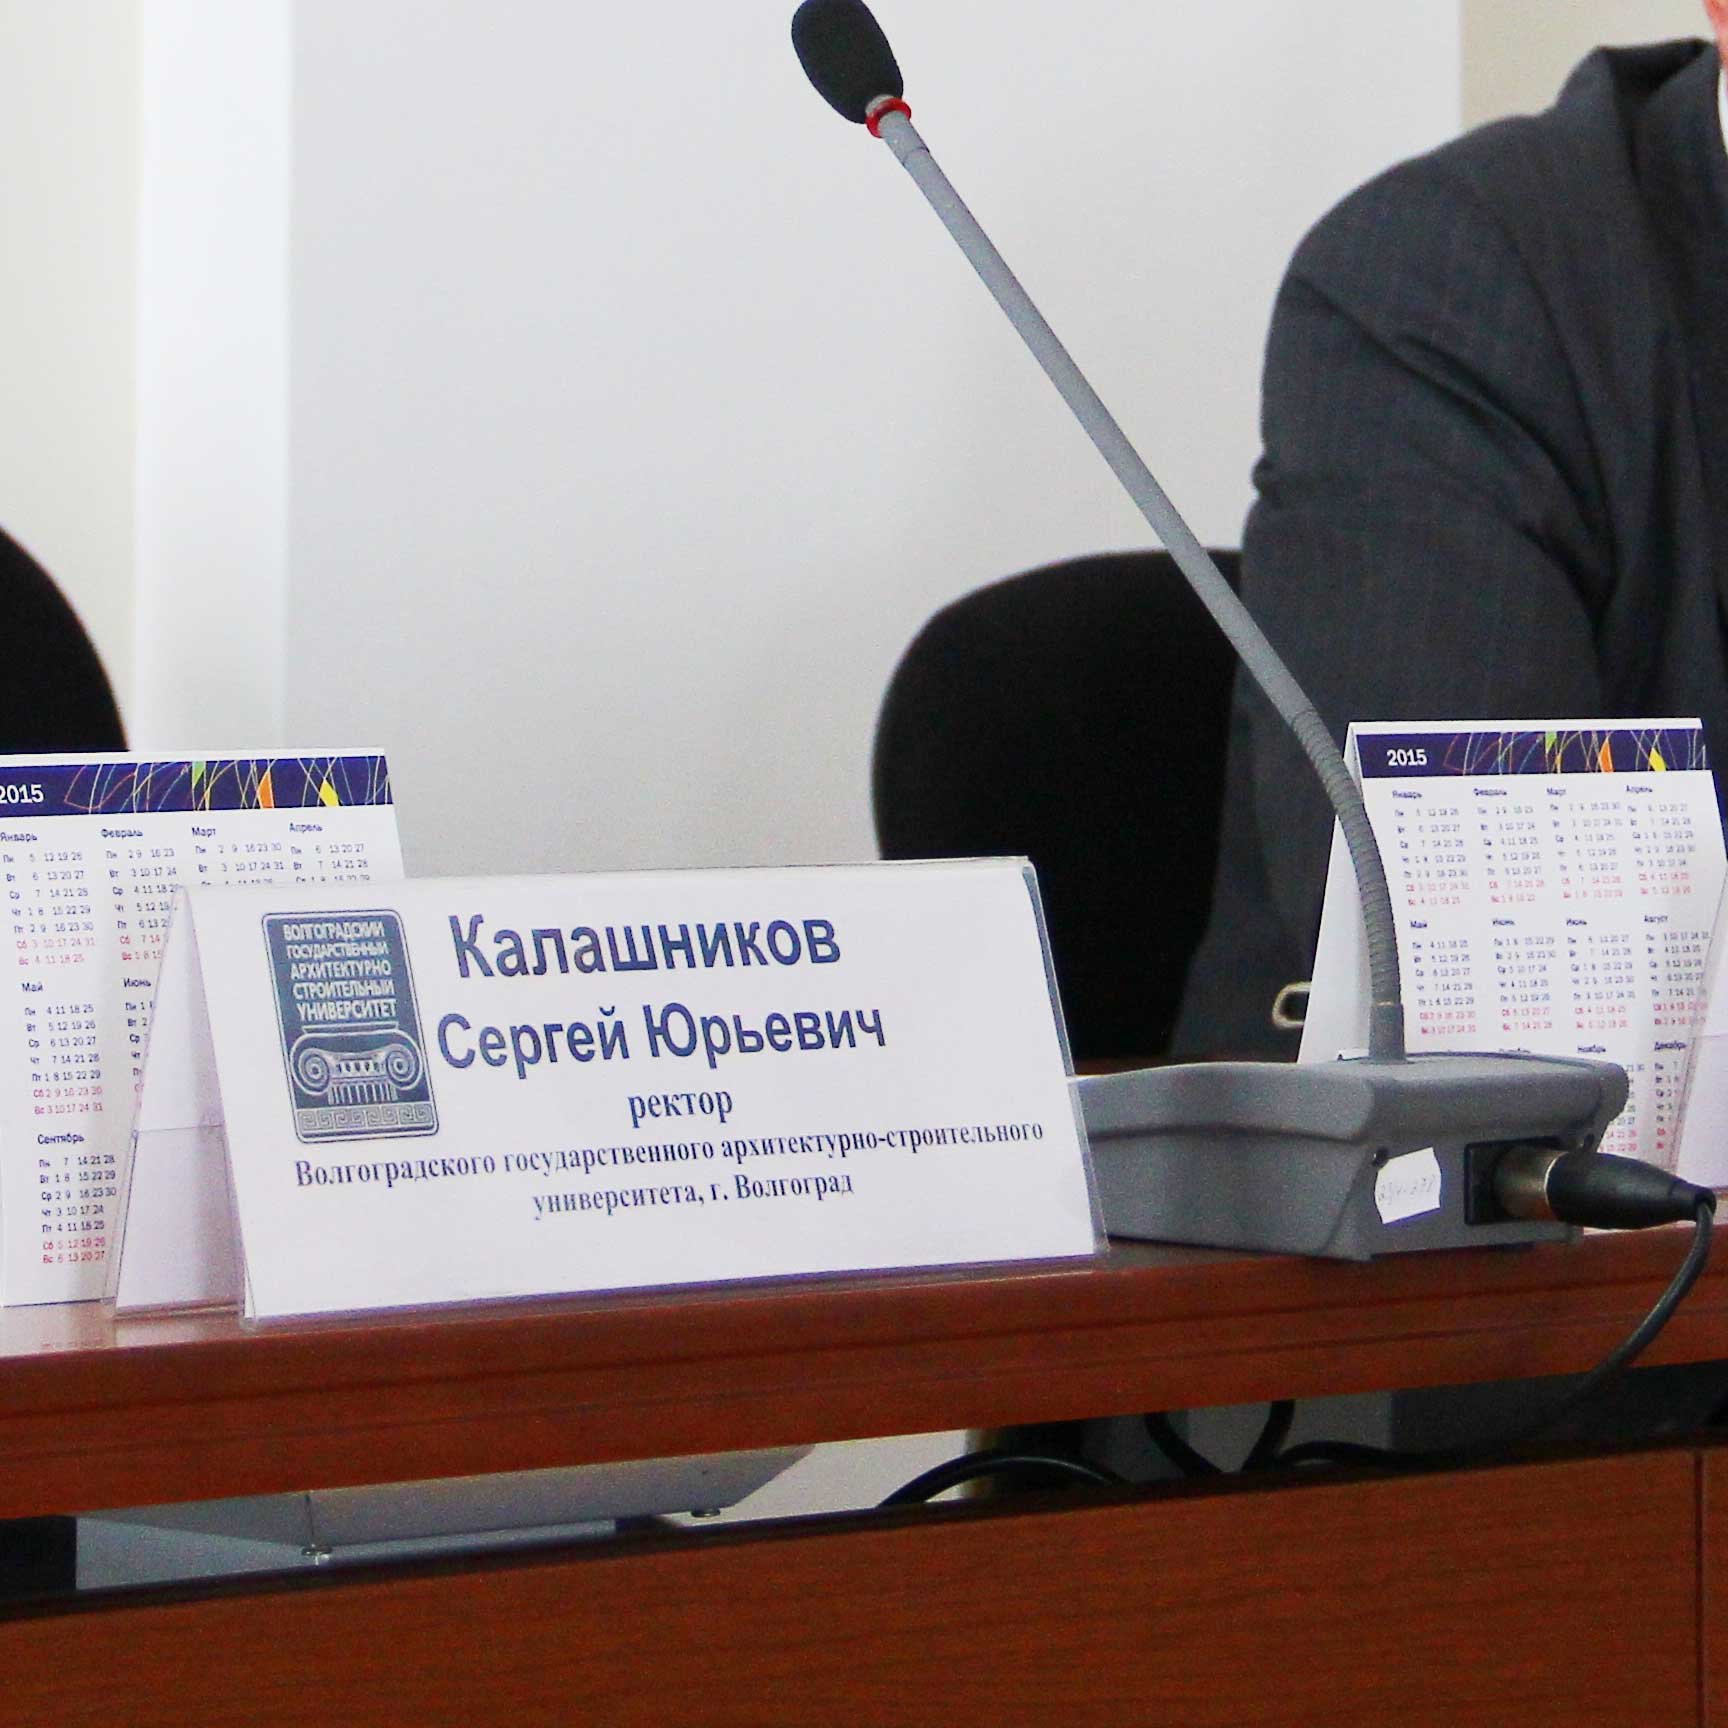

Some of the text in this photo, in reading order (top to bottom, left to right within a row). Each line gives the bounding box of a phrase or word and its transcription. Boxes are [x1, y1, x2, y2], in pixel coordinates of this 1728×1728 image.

[1387, 749, 1428, 766] 2015
[101, 828, 143, 839] Февраль
[191, 826, 216, 838] Март
[289, 822, 323, 833] Апрель
[0, 831, 38, 842] Январь
[448, 912, 841, 978] Калашников
[291, 959, 392, 980] АРХИТЕКТУРНО
[22, 982, 43, 992] Май
[123, 977, 151, 988] Июнь
[297, 999, 397, 1021] УНИВЕРСИТЕТ
[436, 1002, 886, 1079] Сергей Юрьевич
[627, 1090, 733, 1128] ректор
[37, 1133, 84, 1144] Сентябрь
[294, 1121, 1043, 1188] Волгоградского государственного архитектурно-строительного
[533, 1172, 853, 1220] университета, г. Волгоград
